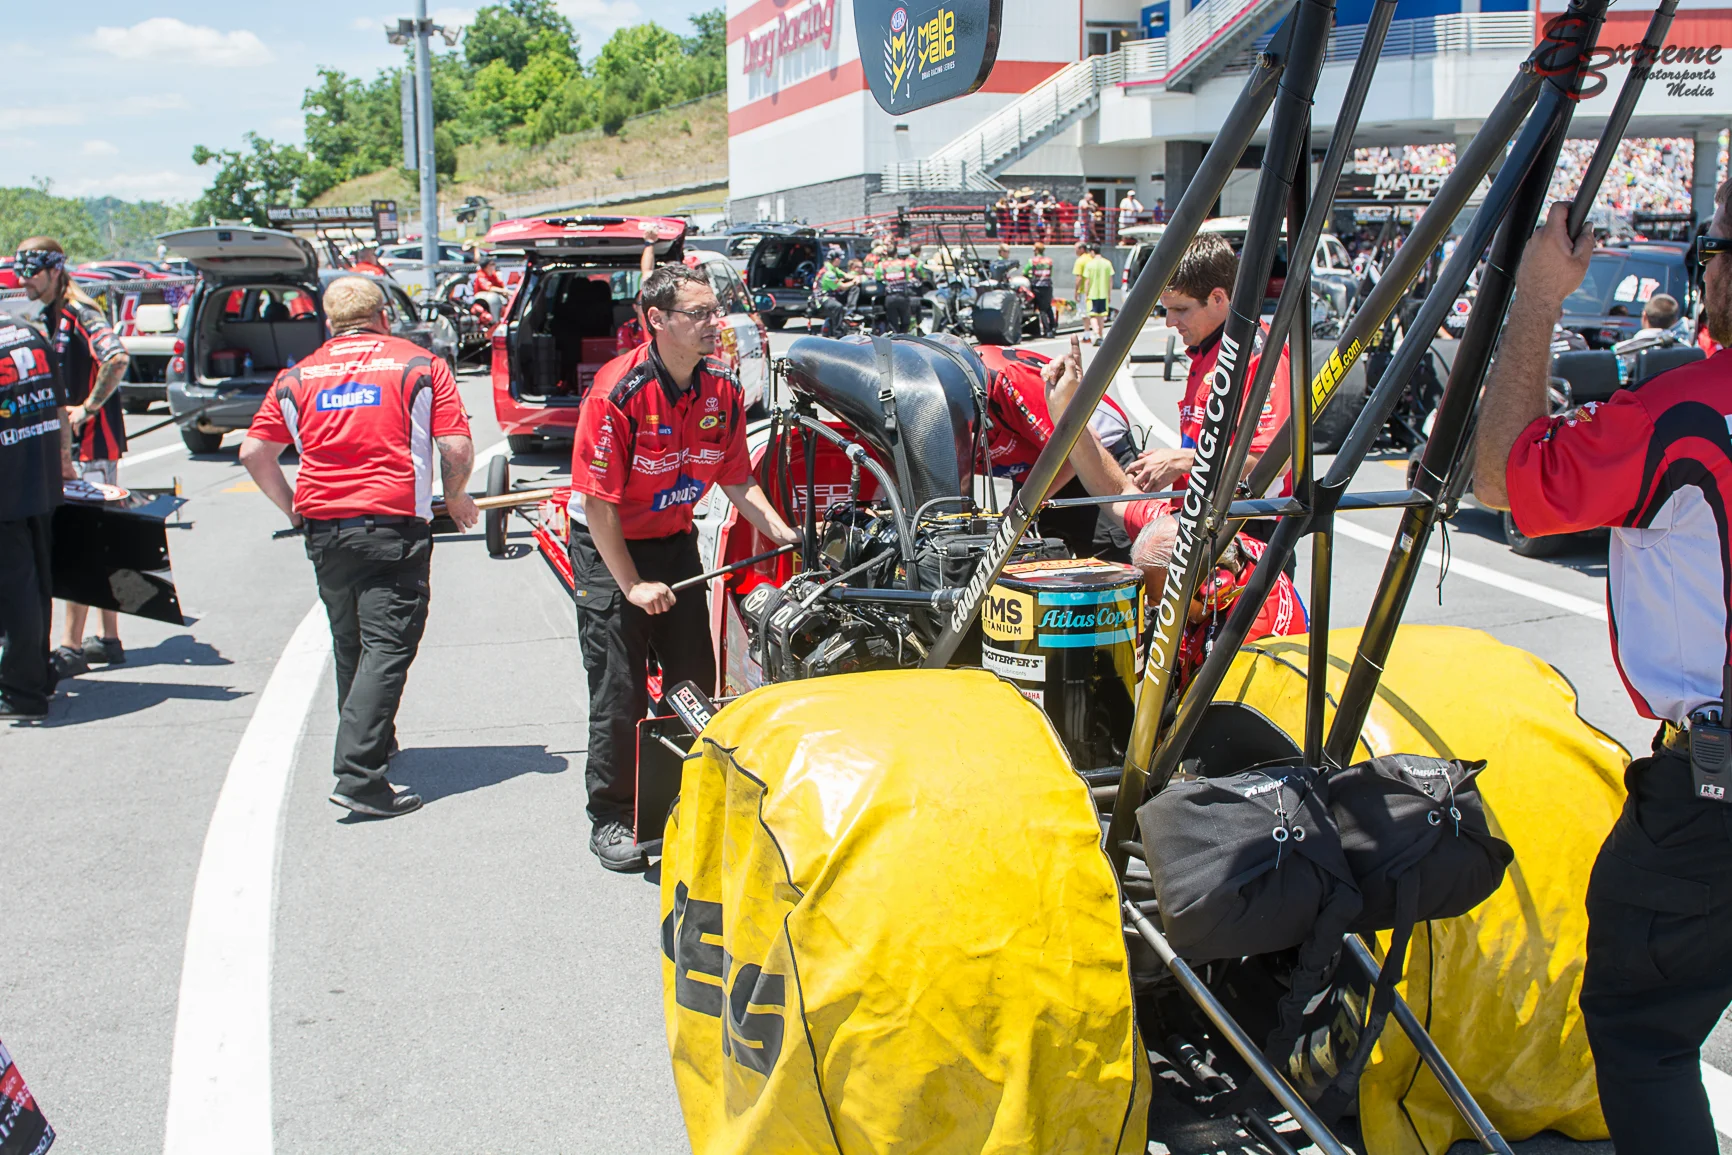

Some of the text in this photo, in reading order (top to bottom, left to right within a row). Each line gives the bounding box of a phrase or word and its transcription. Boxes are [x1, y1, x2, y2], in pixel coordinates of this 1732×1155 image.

[743, 0, 835, 79] Drag Racing
[951, 515, 1017, 634] GOODYEAR
[1038, 607, 1137, 628] Atlas Copco
